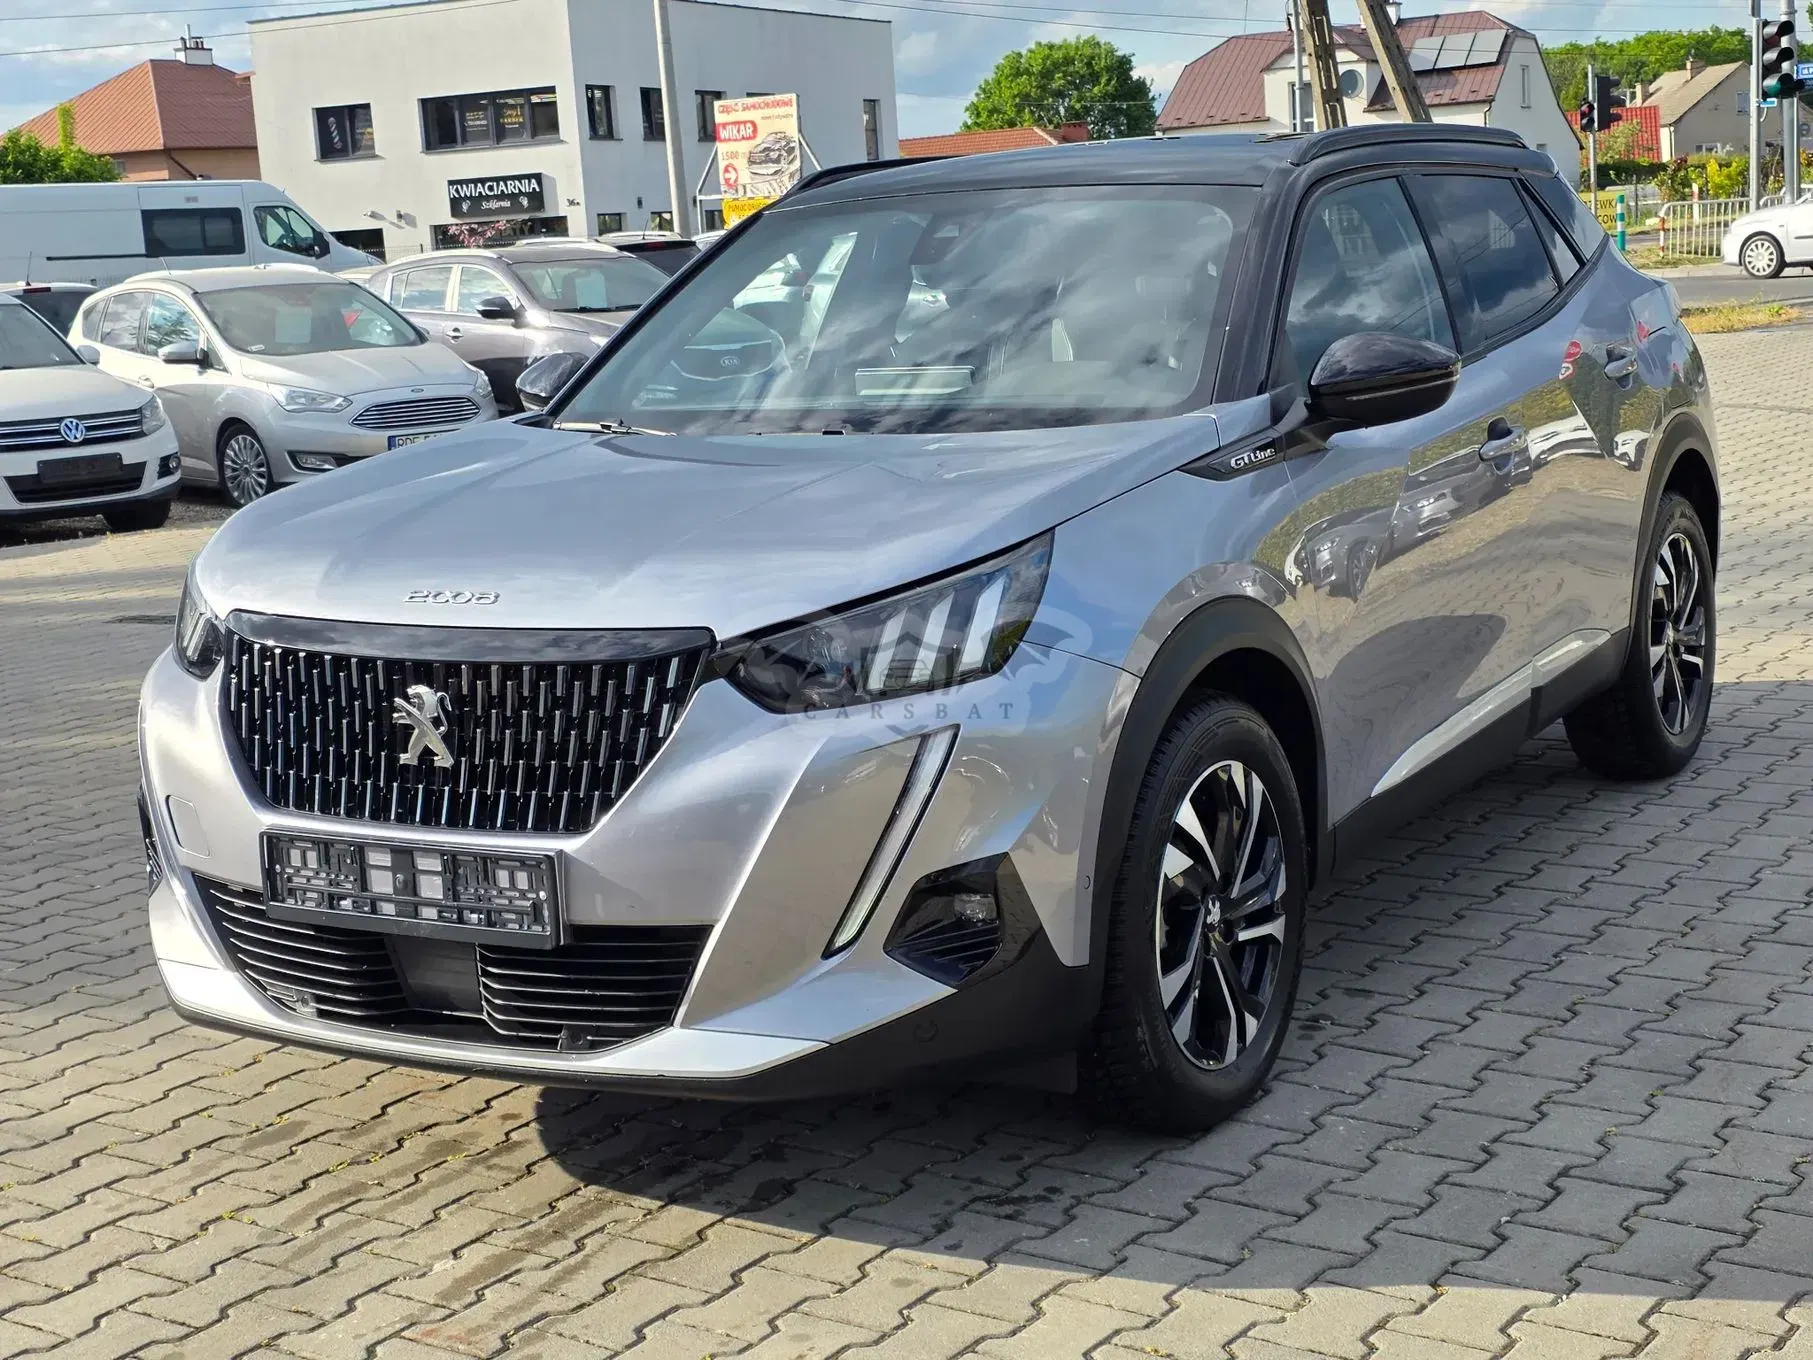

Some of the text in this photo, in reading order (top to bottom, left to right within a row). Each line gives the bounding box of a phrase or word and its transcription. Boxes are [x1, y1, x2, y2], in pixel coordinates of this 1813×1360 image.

[720, 123, 753, 140] WIKAR
[450, 178, 540, 199] KWIACIARNIA
[403, 589, 501, 605] 2008
